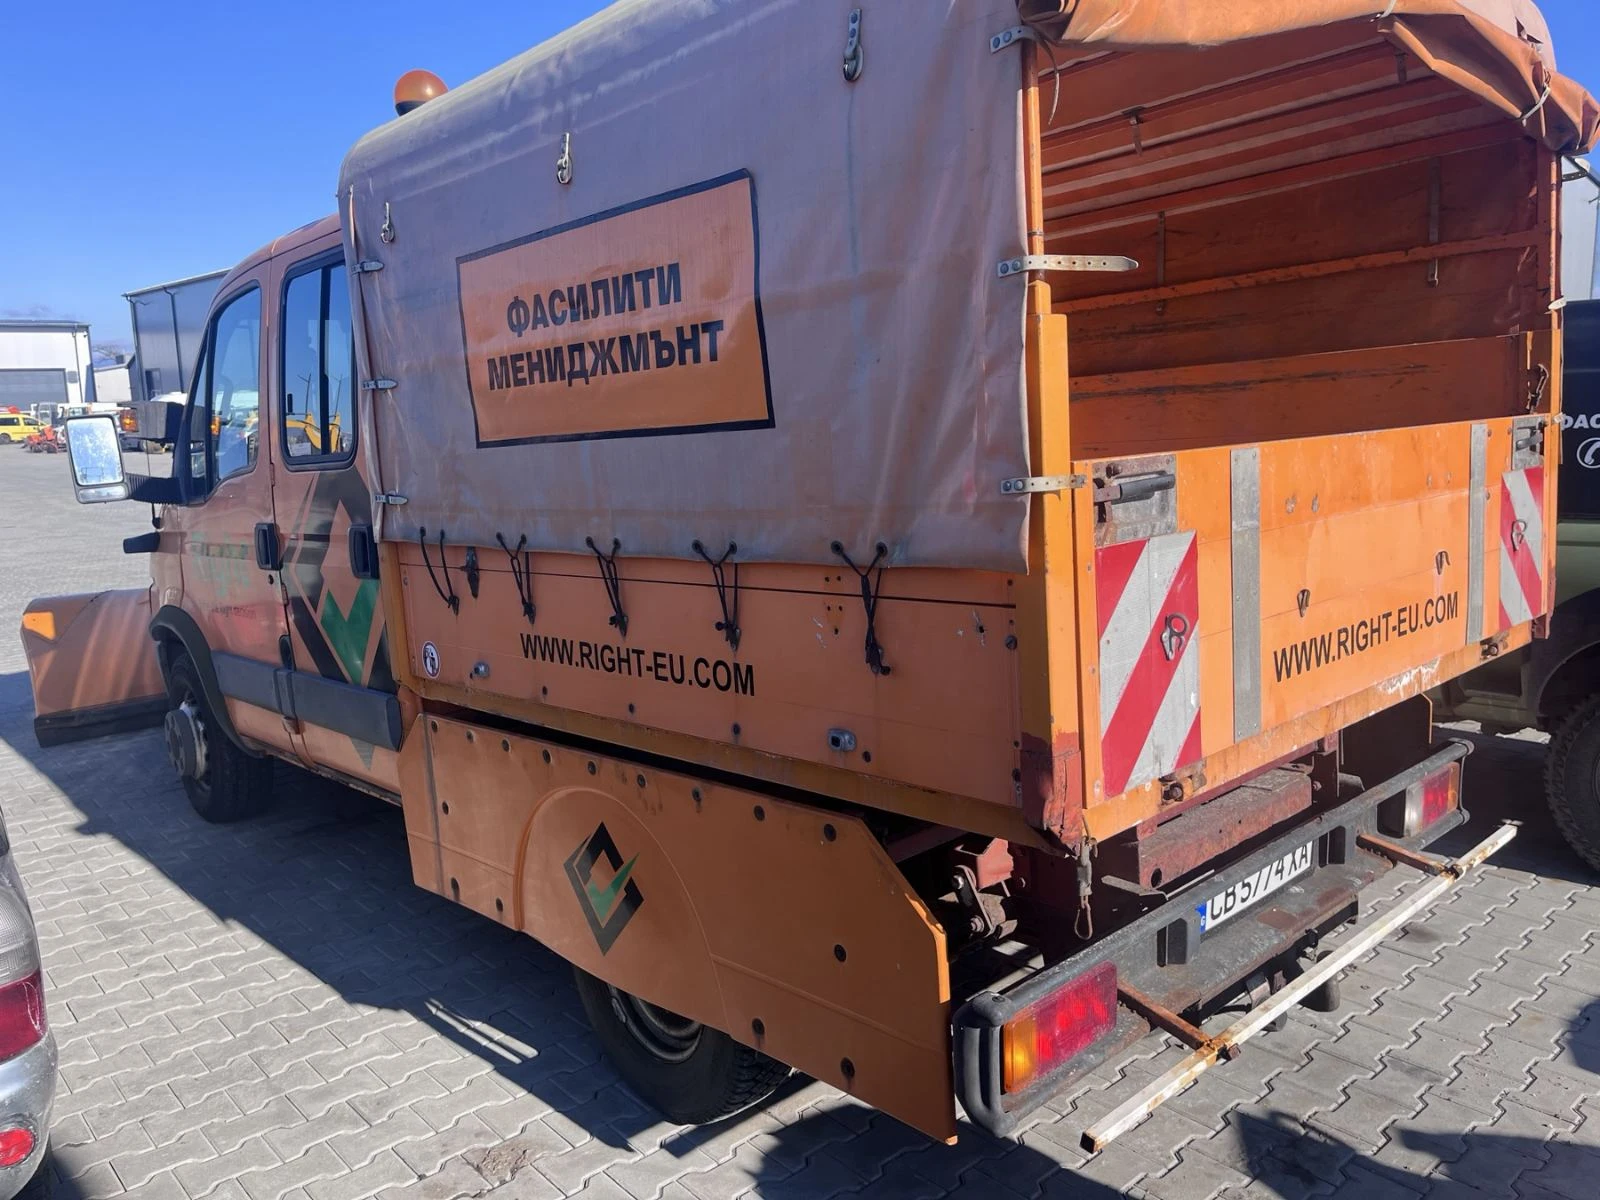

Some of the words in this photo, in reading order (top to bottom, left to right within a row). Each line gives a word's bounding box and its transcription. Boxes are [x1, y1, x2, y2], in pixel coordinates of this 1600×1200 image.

[507, 263, 682, 337] ФАСИЛИТИ
[487, 320, 724, 390] МЕНИДЖМЪНТ
[520, 633, 755, 696] WWW.RIGHT-EU.COM
[1273, 591, 1458, 682] WWW.RIGHT-EU.COM
